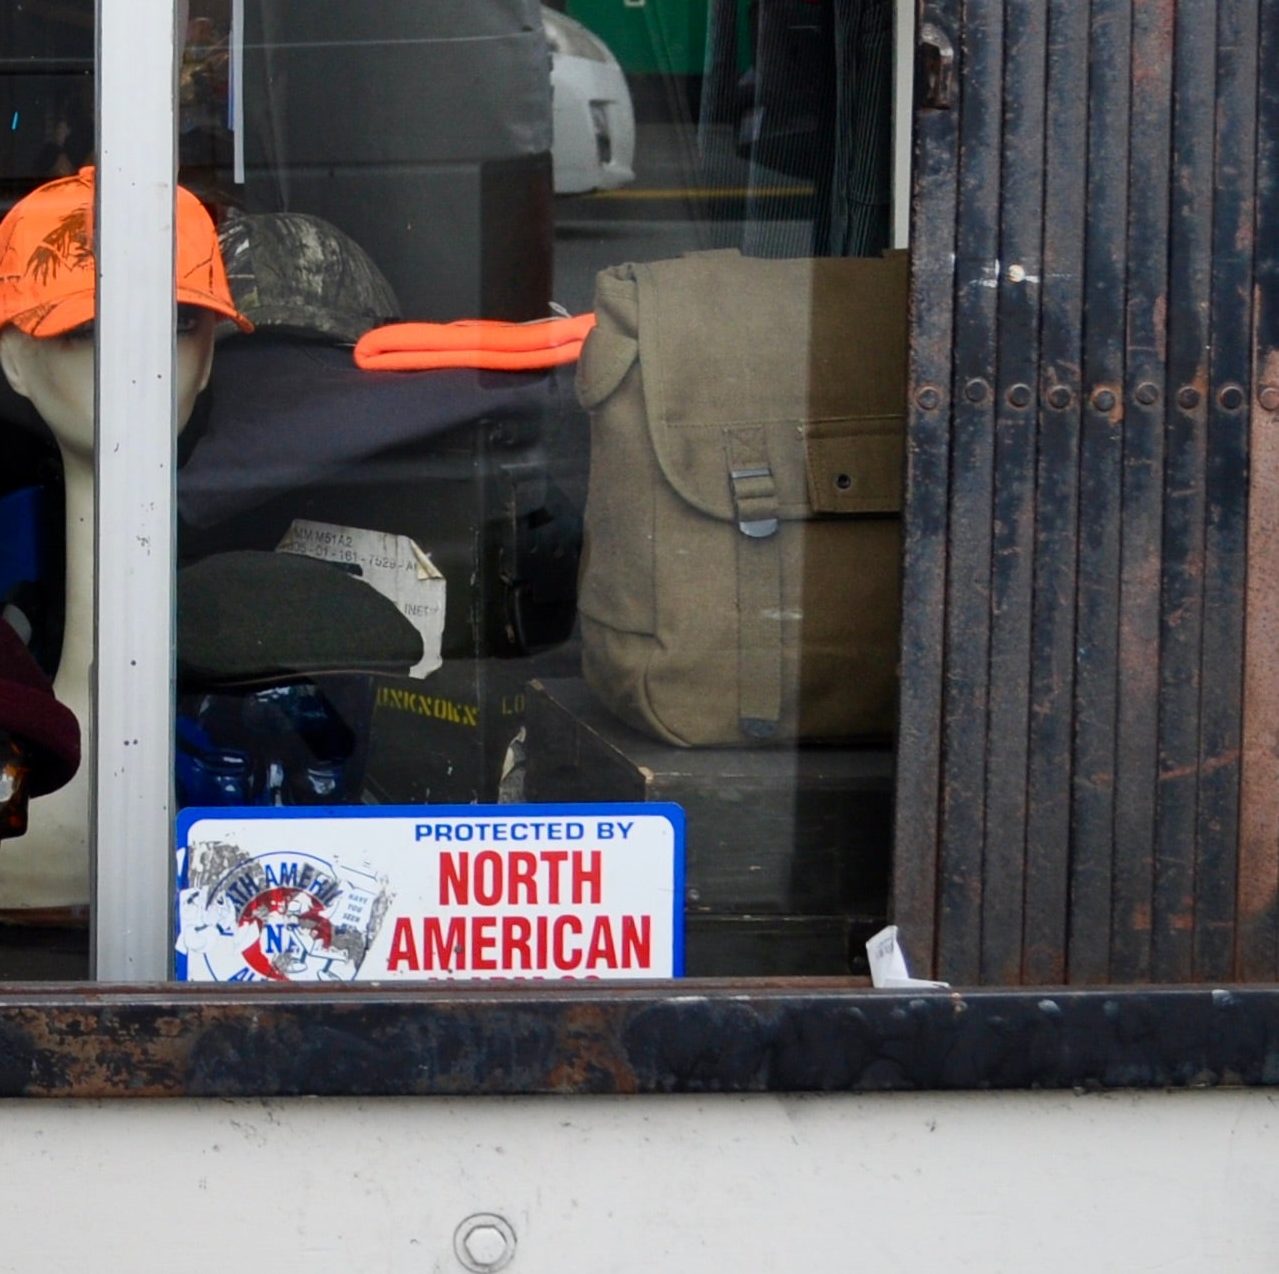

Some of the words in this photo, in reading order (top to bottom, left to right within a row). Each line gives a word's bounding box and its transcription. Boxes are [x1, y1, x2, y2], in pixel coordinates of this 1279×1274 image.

[377, 686, 480, 727] UNKNOWN
[415, 822, 584, 842] PROTECTED
[597, 822, 634, 840] BY
[439, 849, 602, 906] NORTH
[387, 914, 651, 971] AMERICAN
